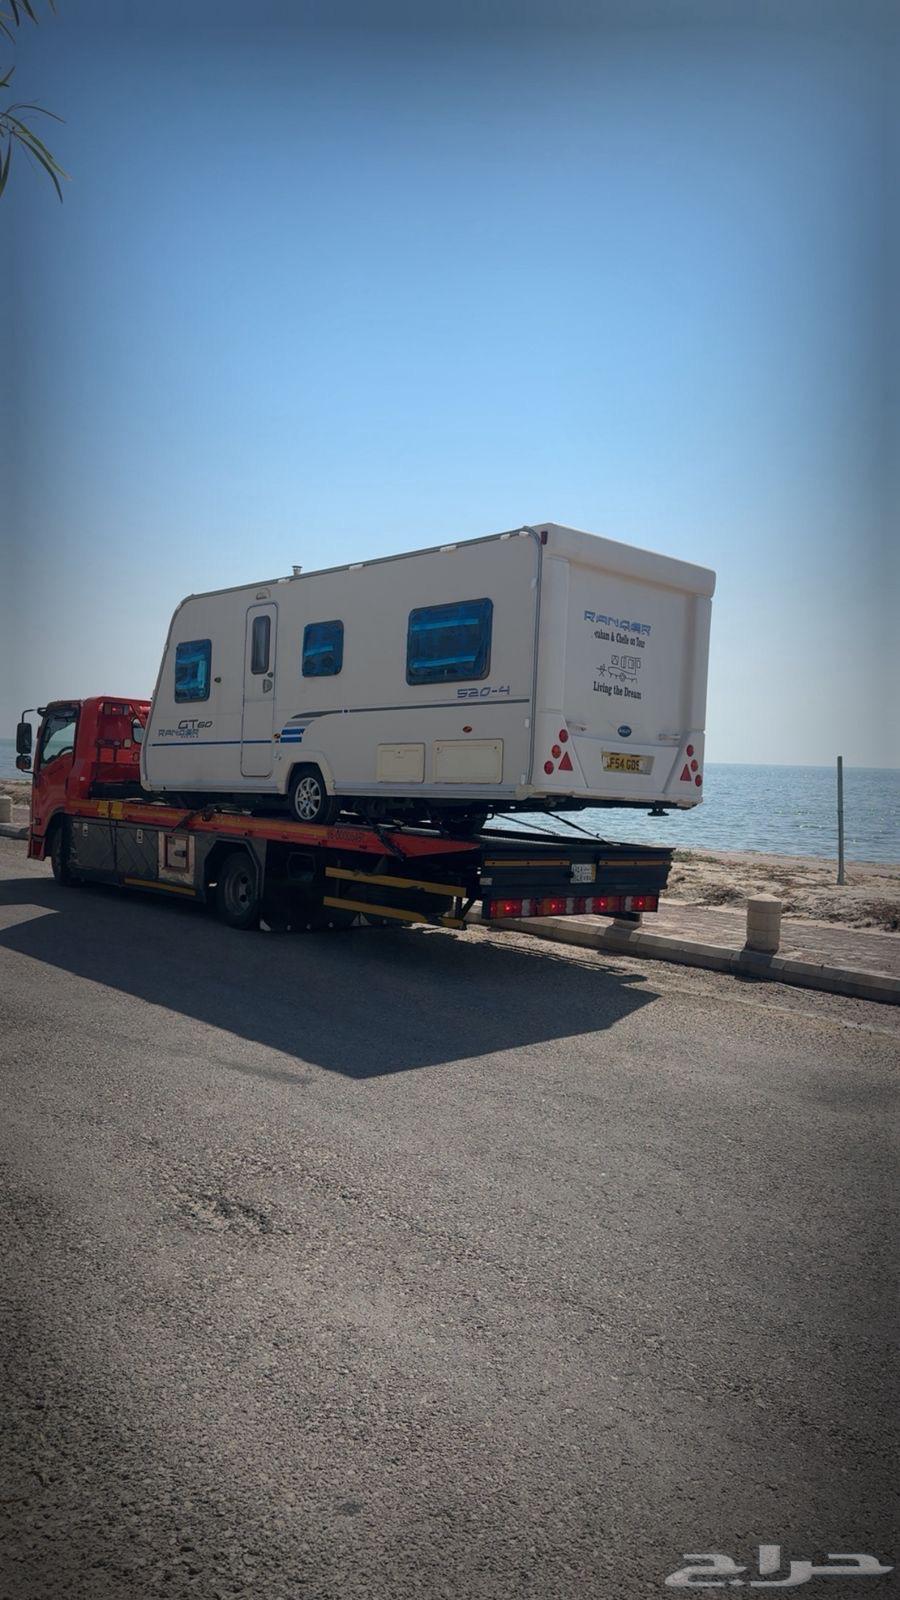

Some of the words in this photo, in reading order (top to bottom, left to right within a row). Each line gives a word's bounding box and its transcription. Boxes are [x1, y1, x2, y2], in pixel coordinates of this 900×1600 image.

[584, 610, 652, 636] RANGER
[611, 631, 616, 642] &
[636, 636, 646, 648] Tour
[457, 685, 510, 698] 520-4
[593, 681, 612, 696] Living
[613, 685, 624, 697] the
[624, 687, 642, 700] Dream
